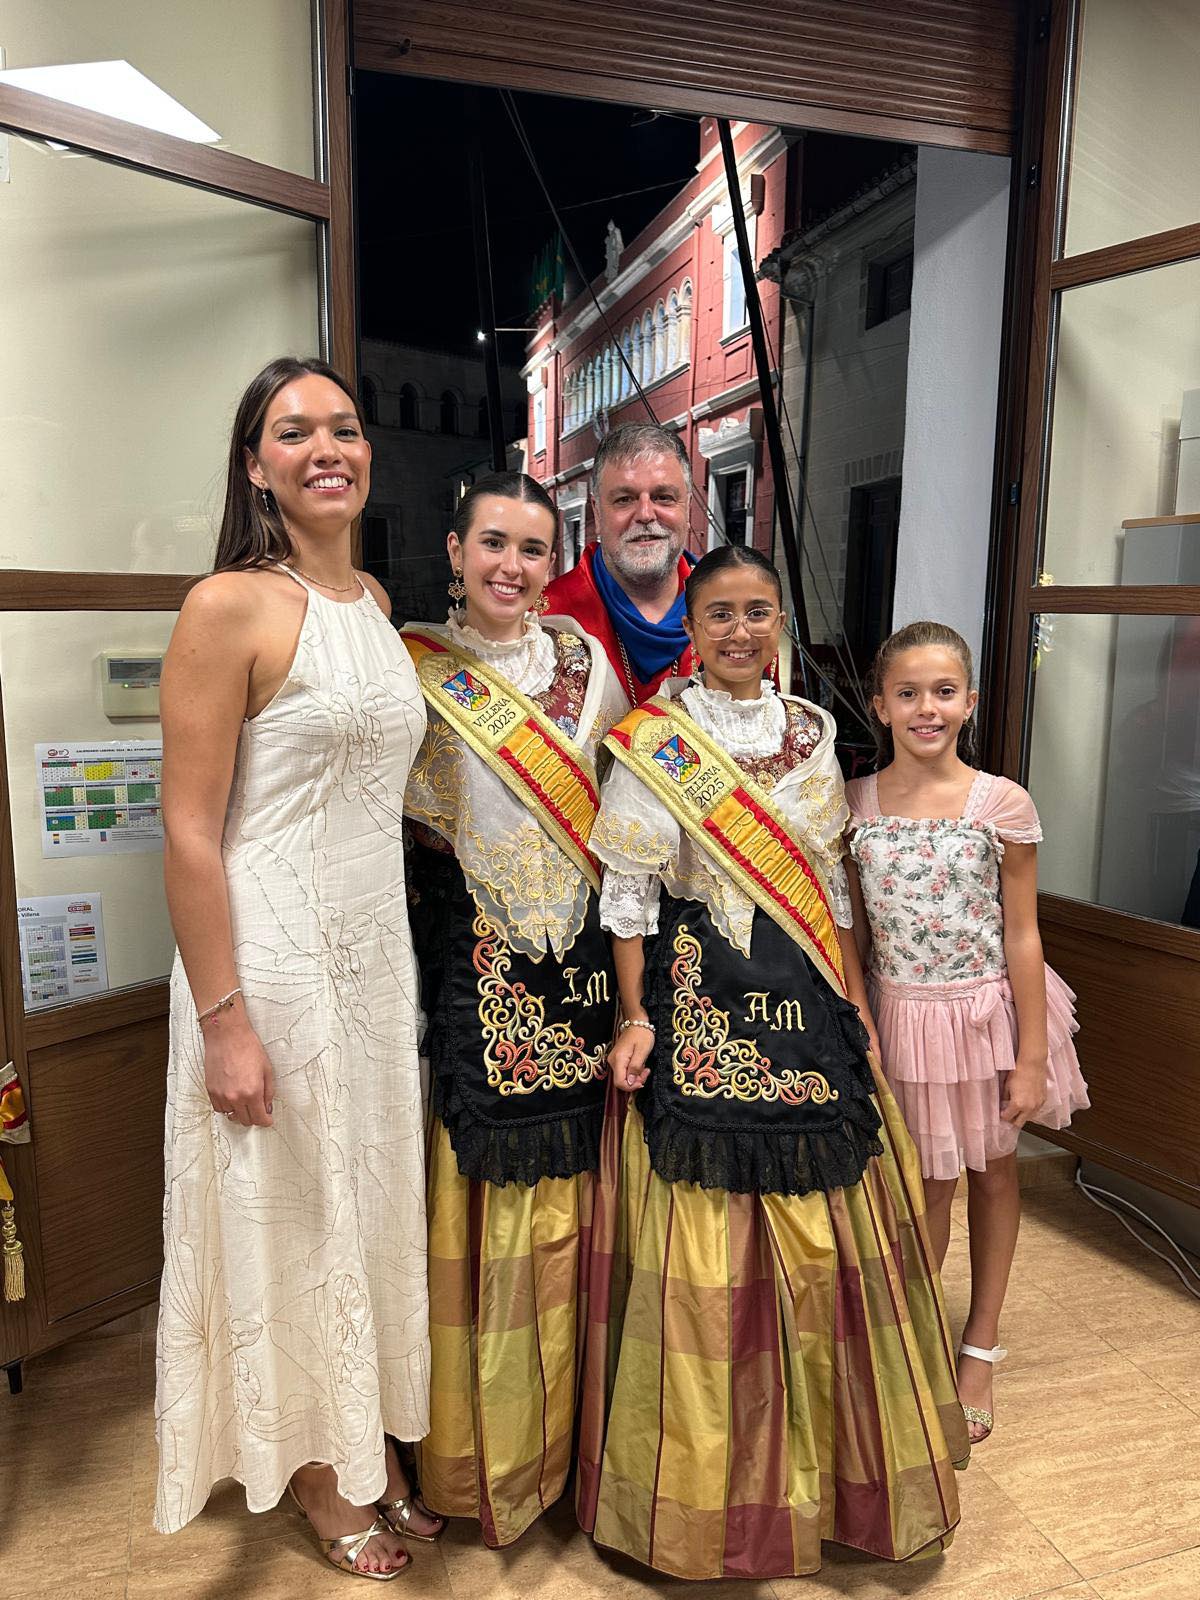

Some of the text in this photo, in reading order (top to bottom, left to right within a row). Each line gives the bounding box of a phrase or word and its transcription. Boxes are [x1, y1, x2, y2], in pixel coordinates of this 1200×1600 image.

[473, 698, 511, 727] VILLENA
[487, 708, 516, 736] 2025
[681, 765, 721, 800] VILLENA
[694, 777, 725, 809] 2025
